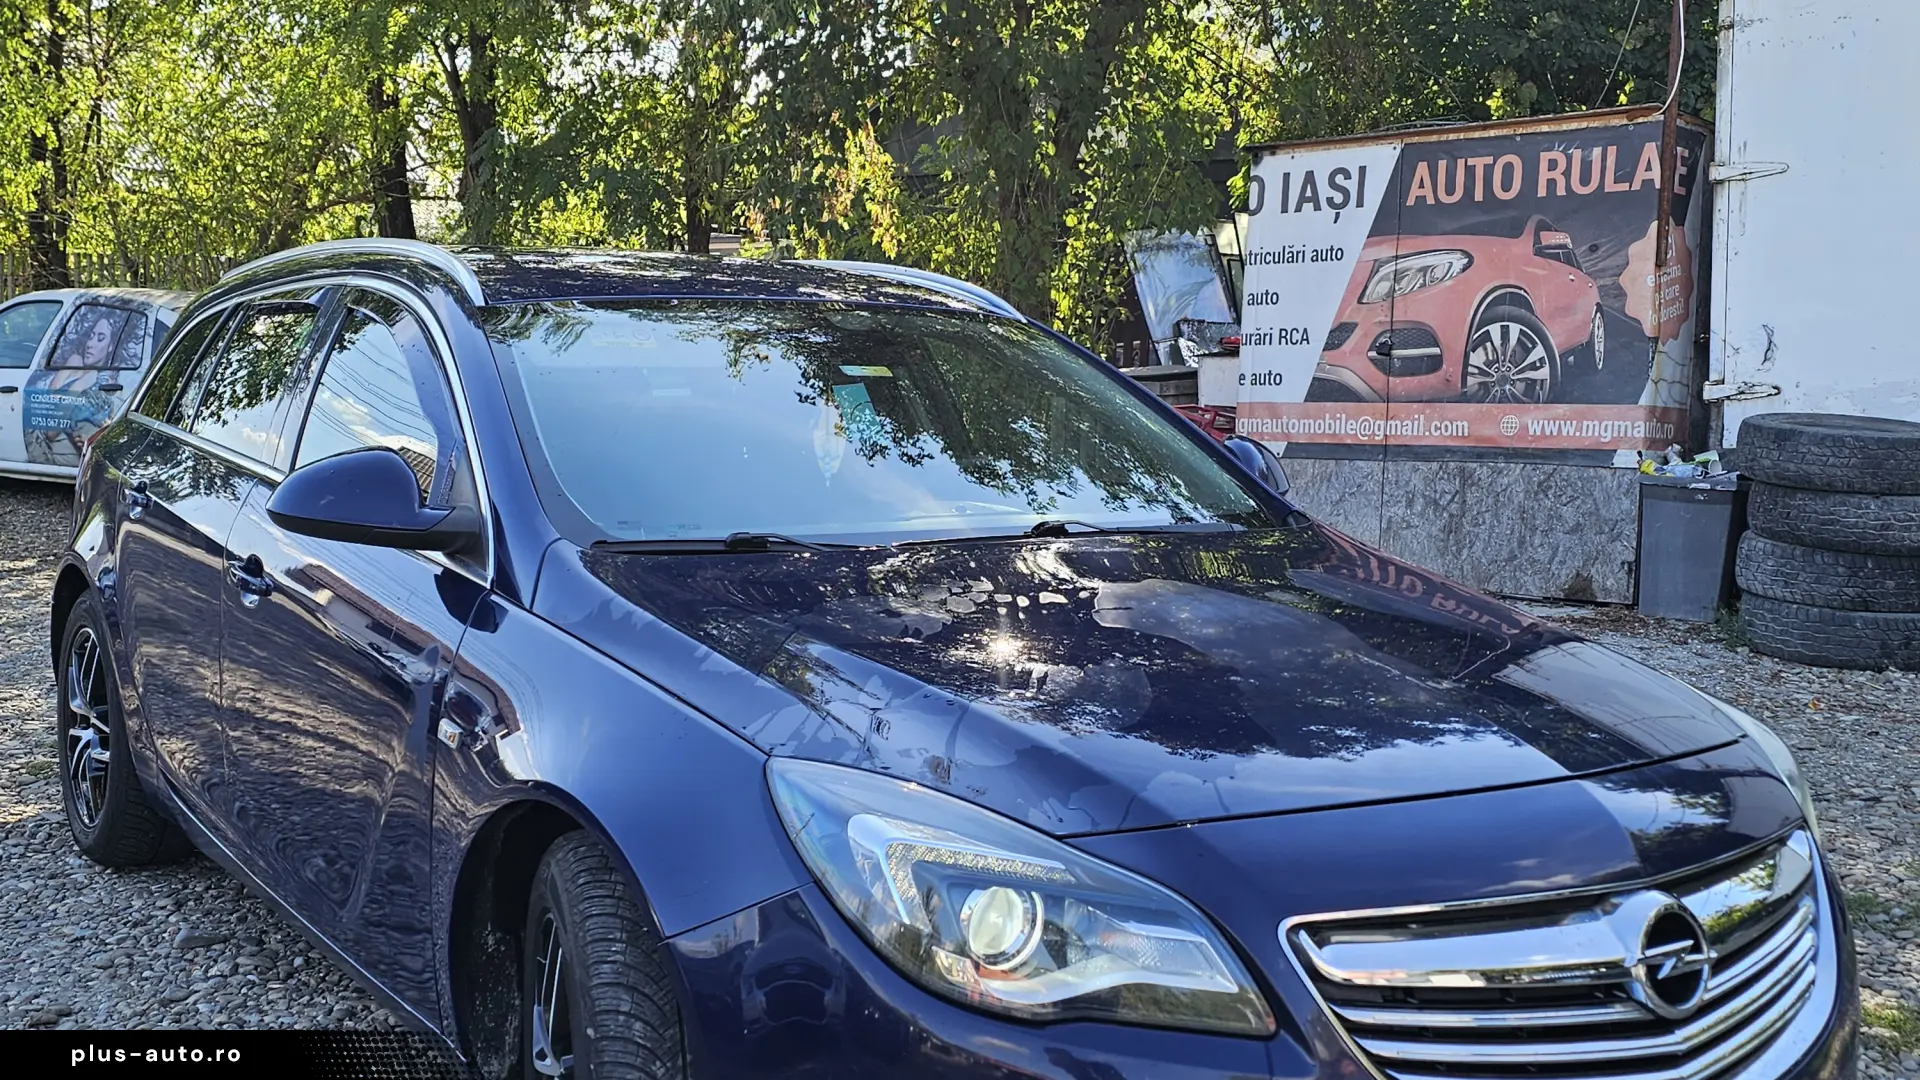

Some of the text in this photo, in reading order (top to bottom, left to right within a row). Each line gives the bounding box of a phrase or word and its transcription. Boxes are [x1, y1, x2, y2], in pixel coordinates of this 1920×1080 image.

[1406, 141, 1690, 206] AUTO RULAE
[1280, 165, 1367, 224] IAȘI
[1310, 245, 1344, 263] auto
[1247, 289, 1280, 306] auto
[1278, 327, 1310, 346] RCA
[1250, 370, 1283, 386] auto
[1527, 418, 1676, 442] www.mgmauto.ro
